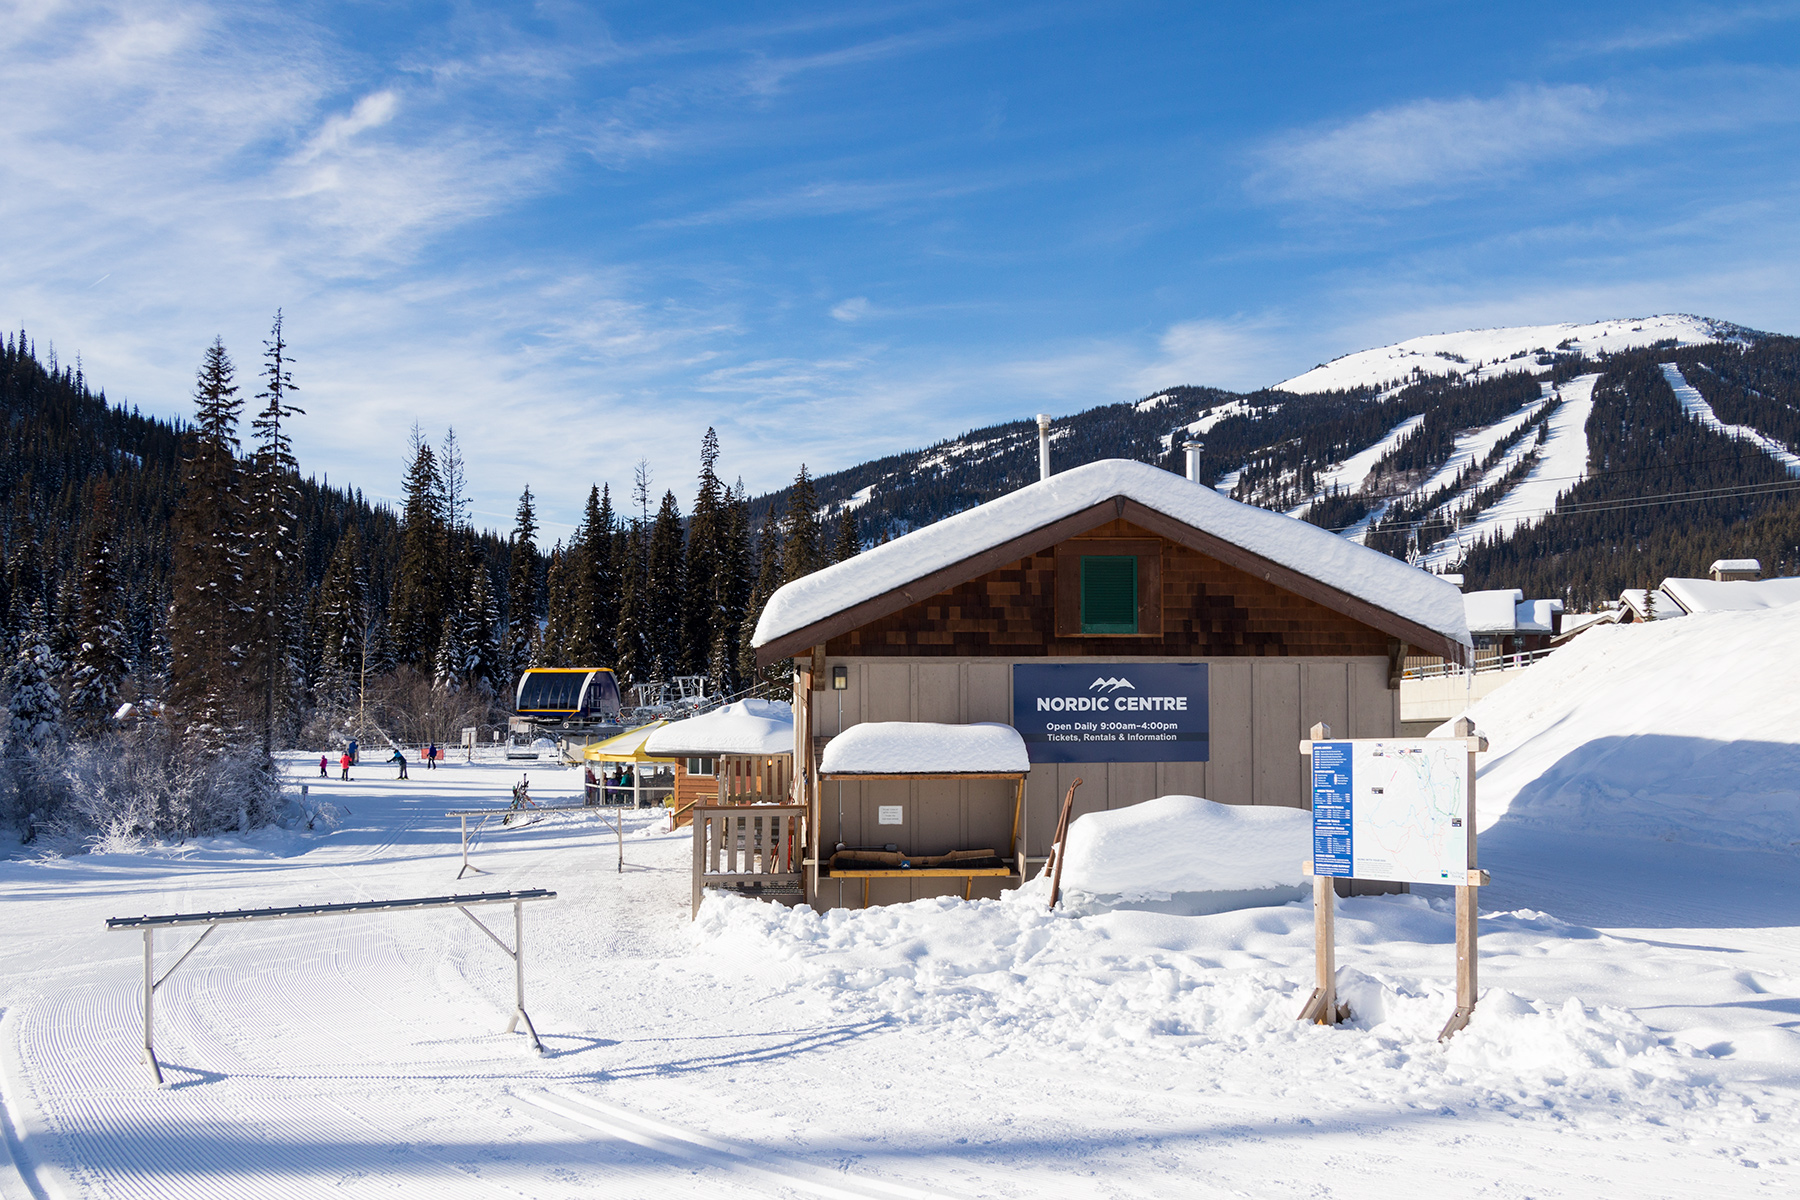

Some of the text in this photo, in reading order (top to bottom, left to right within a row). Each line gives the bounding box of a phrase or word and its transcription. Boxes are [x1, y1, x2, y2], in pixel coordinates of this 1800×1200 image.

[1037, 697, 1187, 711] NORDIC CENTRE
[1047, 722, 1071, 731] Open
[1075, 722, 1097, 731] Daily
[1047, 733, 1177, 742] Tickets, Rentals & Information
